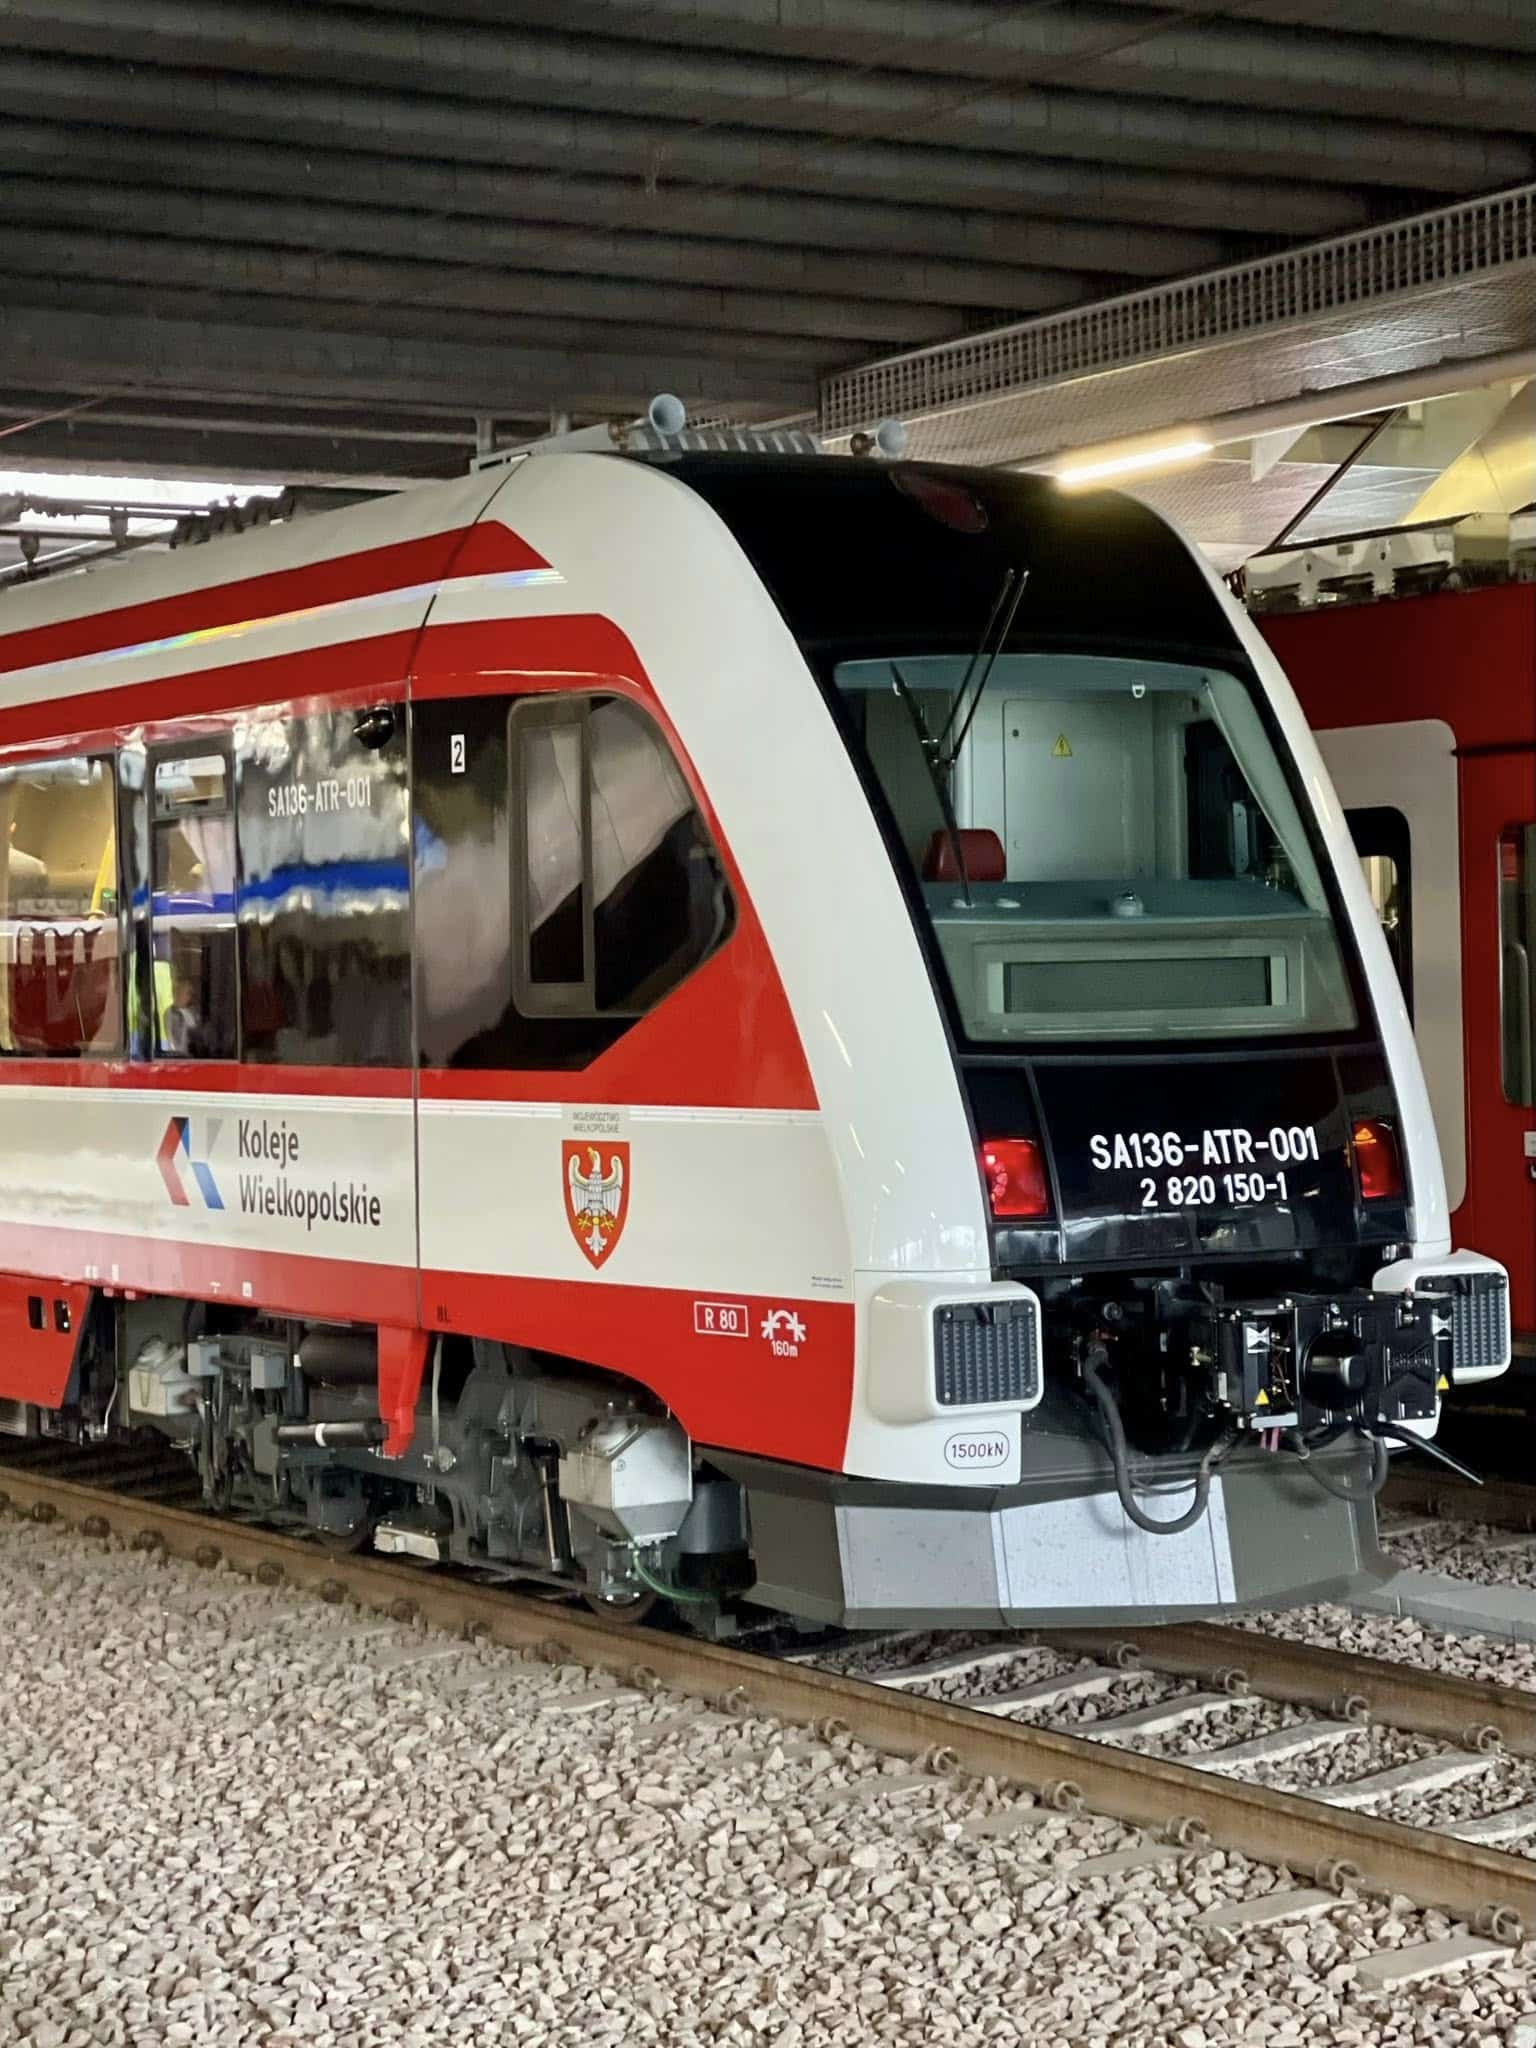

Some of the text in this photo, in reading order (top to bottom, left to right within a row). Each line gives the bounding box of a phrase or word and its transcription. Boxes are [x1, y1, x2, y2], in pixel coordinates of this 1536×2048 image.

[454, 740, 462, 767] 2
[268, 775, 371, 817] SA136-ATR-001
[238, 1119, 299, 1170] Koleje
[1090, 1126, 1320, 1170] SA136-ATR-001
[239, 1173, 382, 1232] Wielkopolskie
[1140, 1171, 1288, 1207] 2 820 150-1
[705, 1307, 737, 1331] R 80
[771, 1340, 798, 1358] 160m
[951, 1442, 1004, 1459] 1500kN
